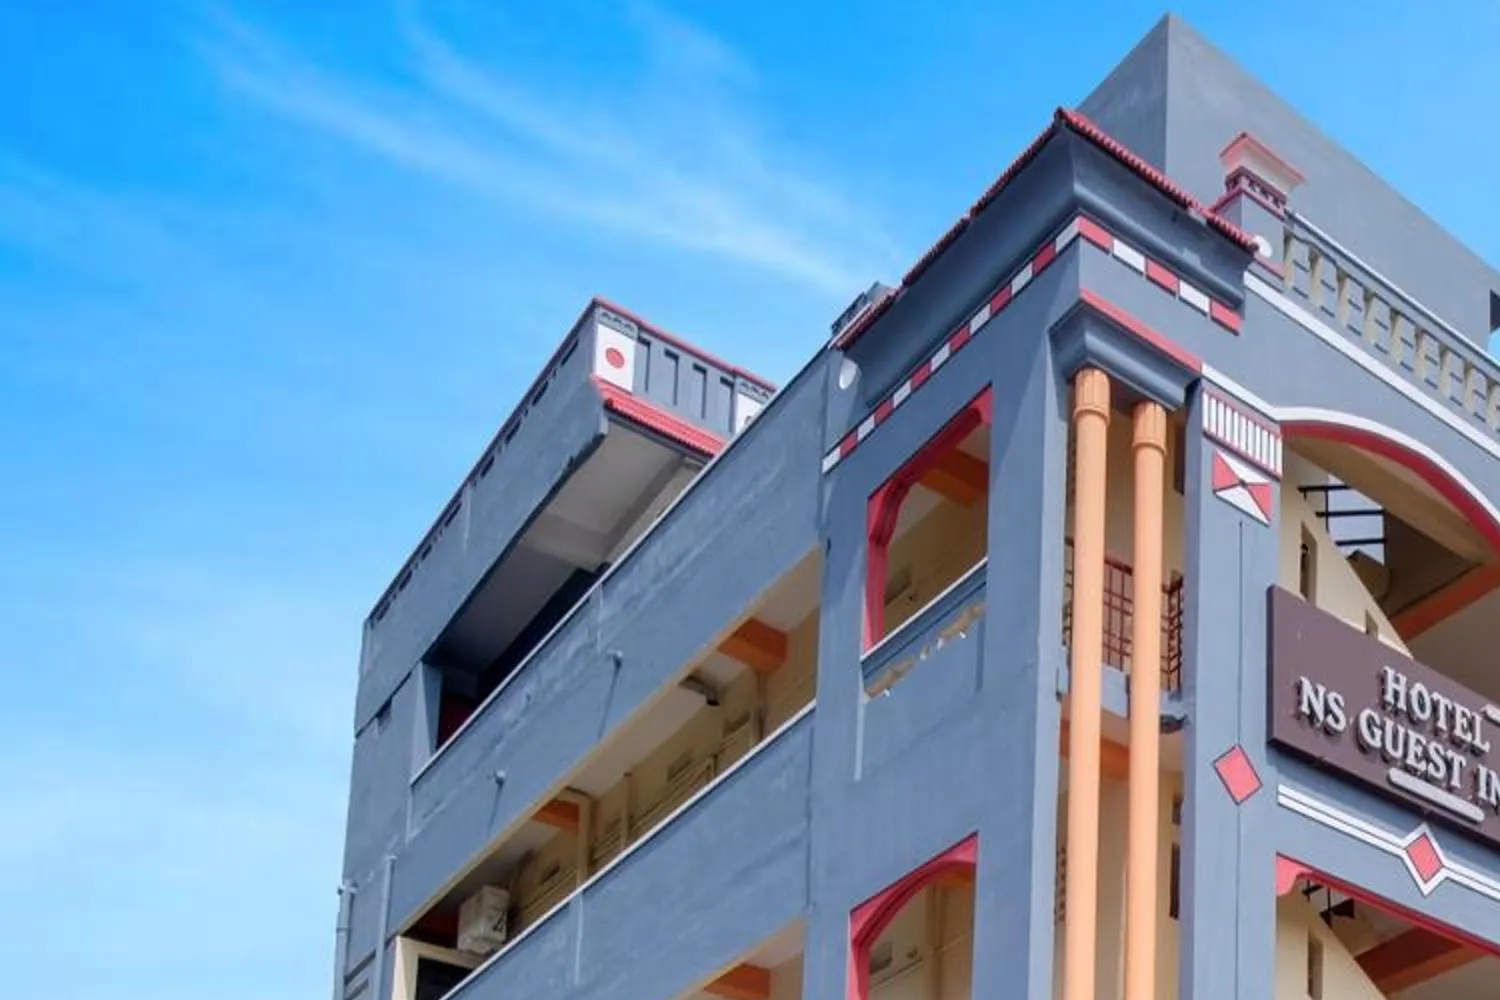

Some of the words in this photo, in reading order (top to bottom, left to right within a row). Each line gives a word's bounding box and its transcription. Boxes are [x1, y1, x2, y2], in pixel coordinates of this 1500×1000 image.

[1298, 676, 1347, 733] NS
[1358, 708, 1467, 789] GUEST
[1382, 665, 1490, 753] HOTEL
